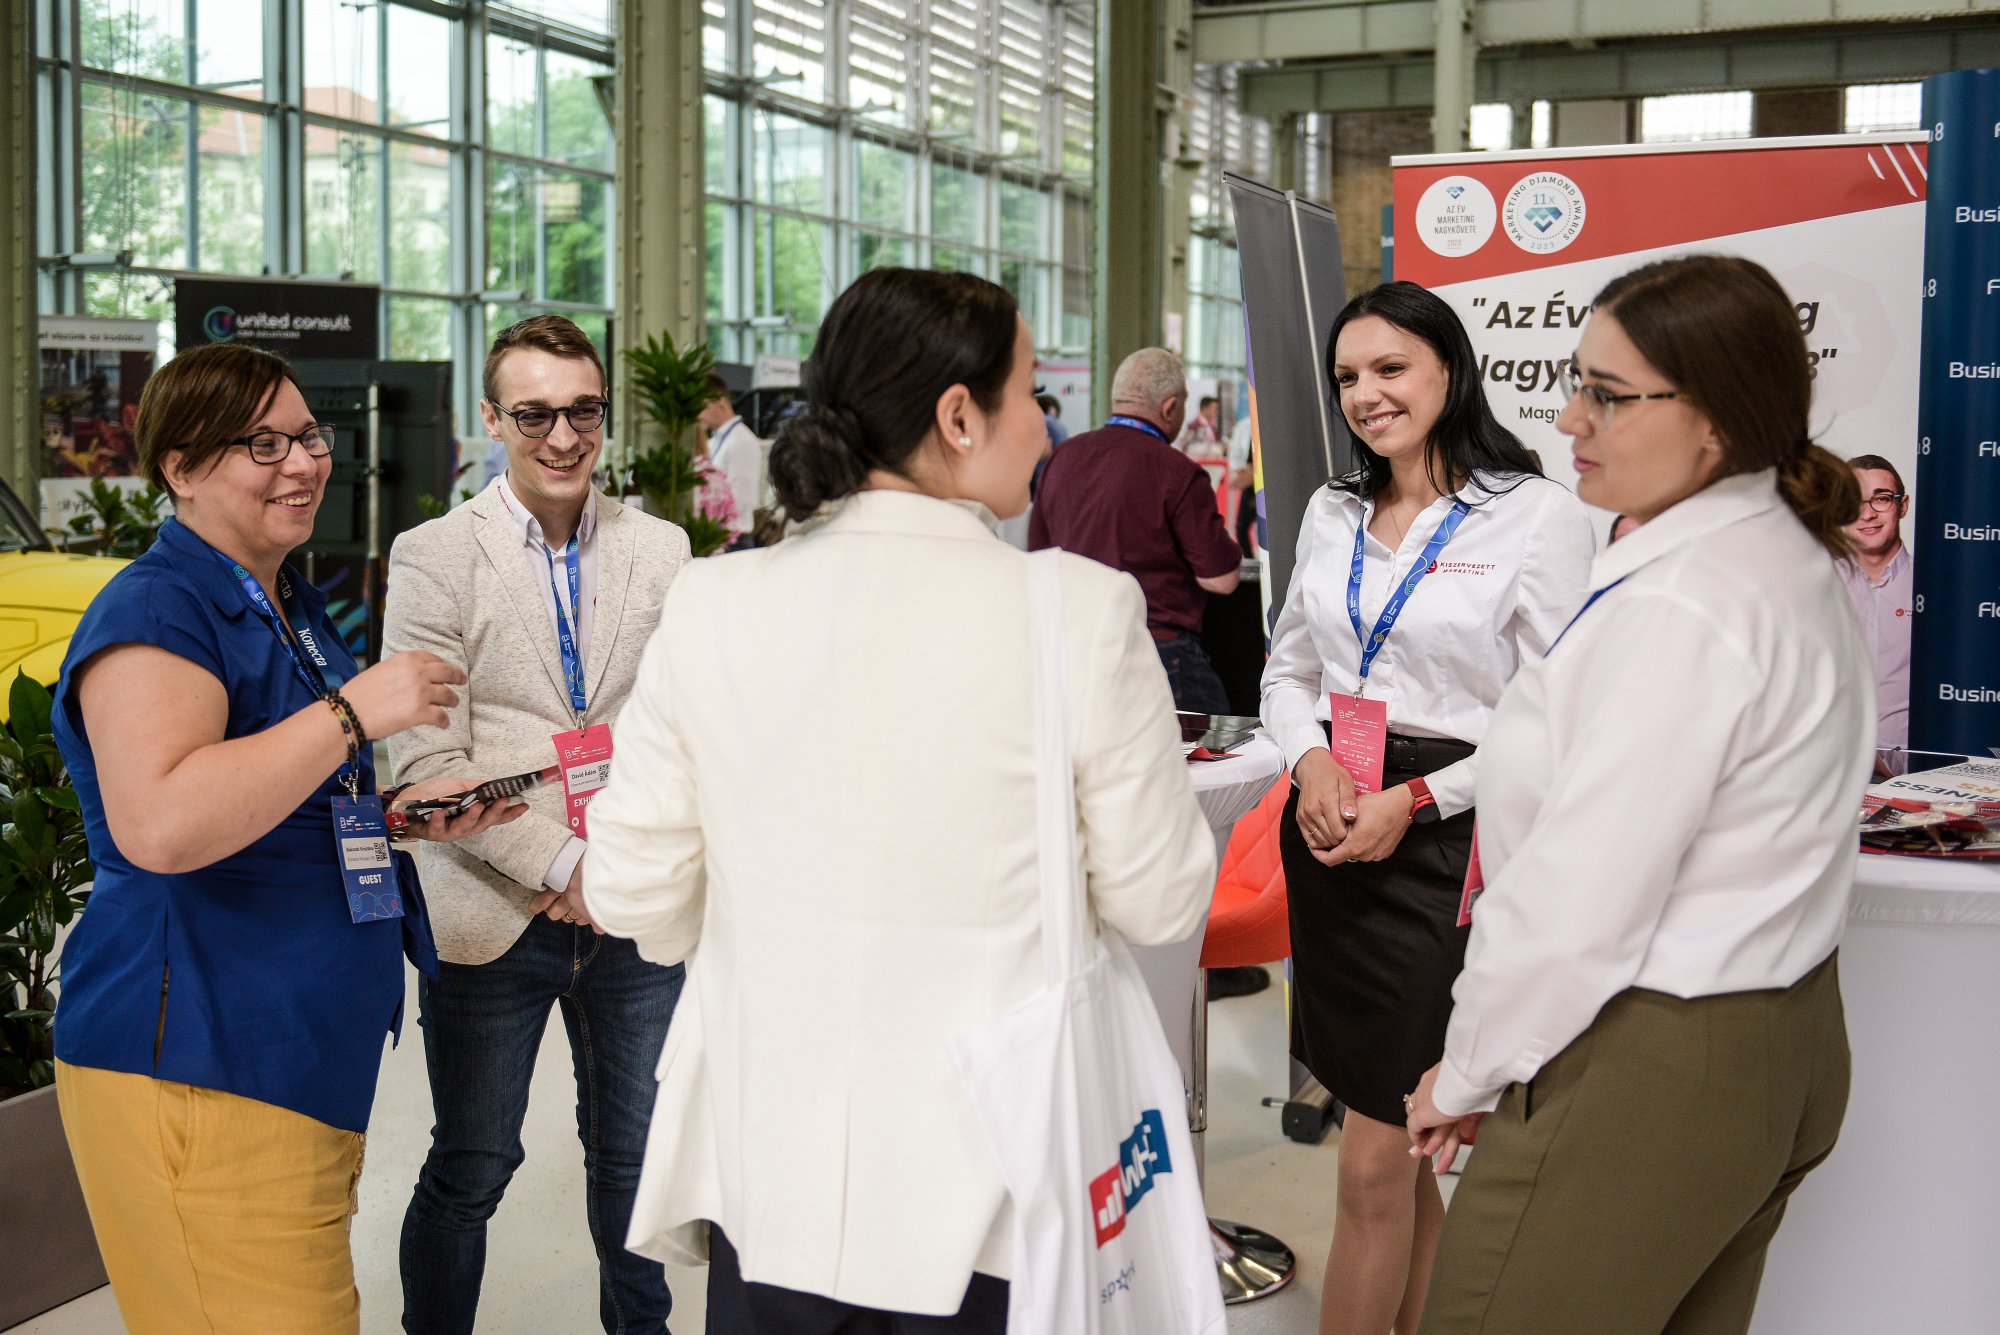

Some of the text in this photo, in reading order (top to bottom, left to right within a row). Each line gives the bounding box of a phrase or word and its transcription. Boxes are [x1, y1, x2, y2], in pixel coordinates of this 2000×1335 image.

[1446, 203, 1466, 214] AZ ÉV
[1506, 176, 1583, 242] MARKETING DIAMOND AWARDS
[1437, 215, 1475, 224] MARKETING
[1472, 298, 1536, 329] "Az
[1542, 290, 1590, 329] Év
[236, 312, 352, 331] united consult
[1440, 562, 1496, 570] KISZERVEZETT
[298, 628, 328, 667] Konecta
[574, 795, 594, 808] EXHI
[359, 874, 382, 885] GUEST
